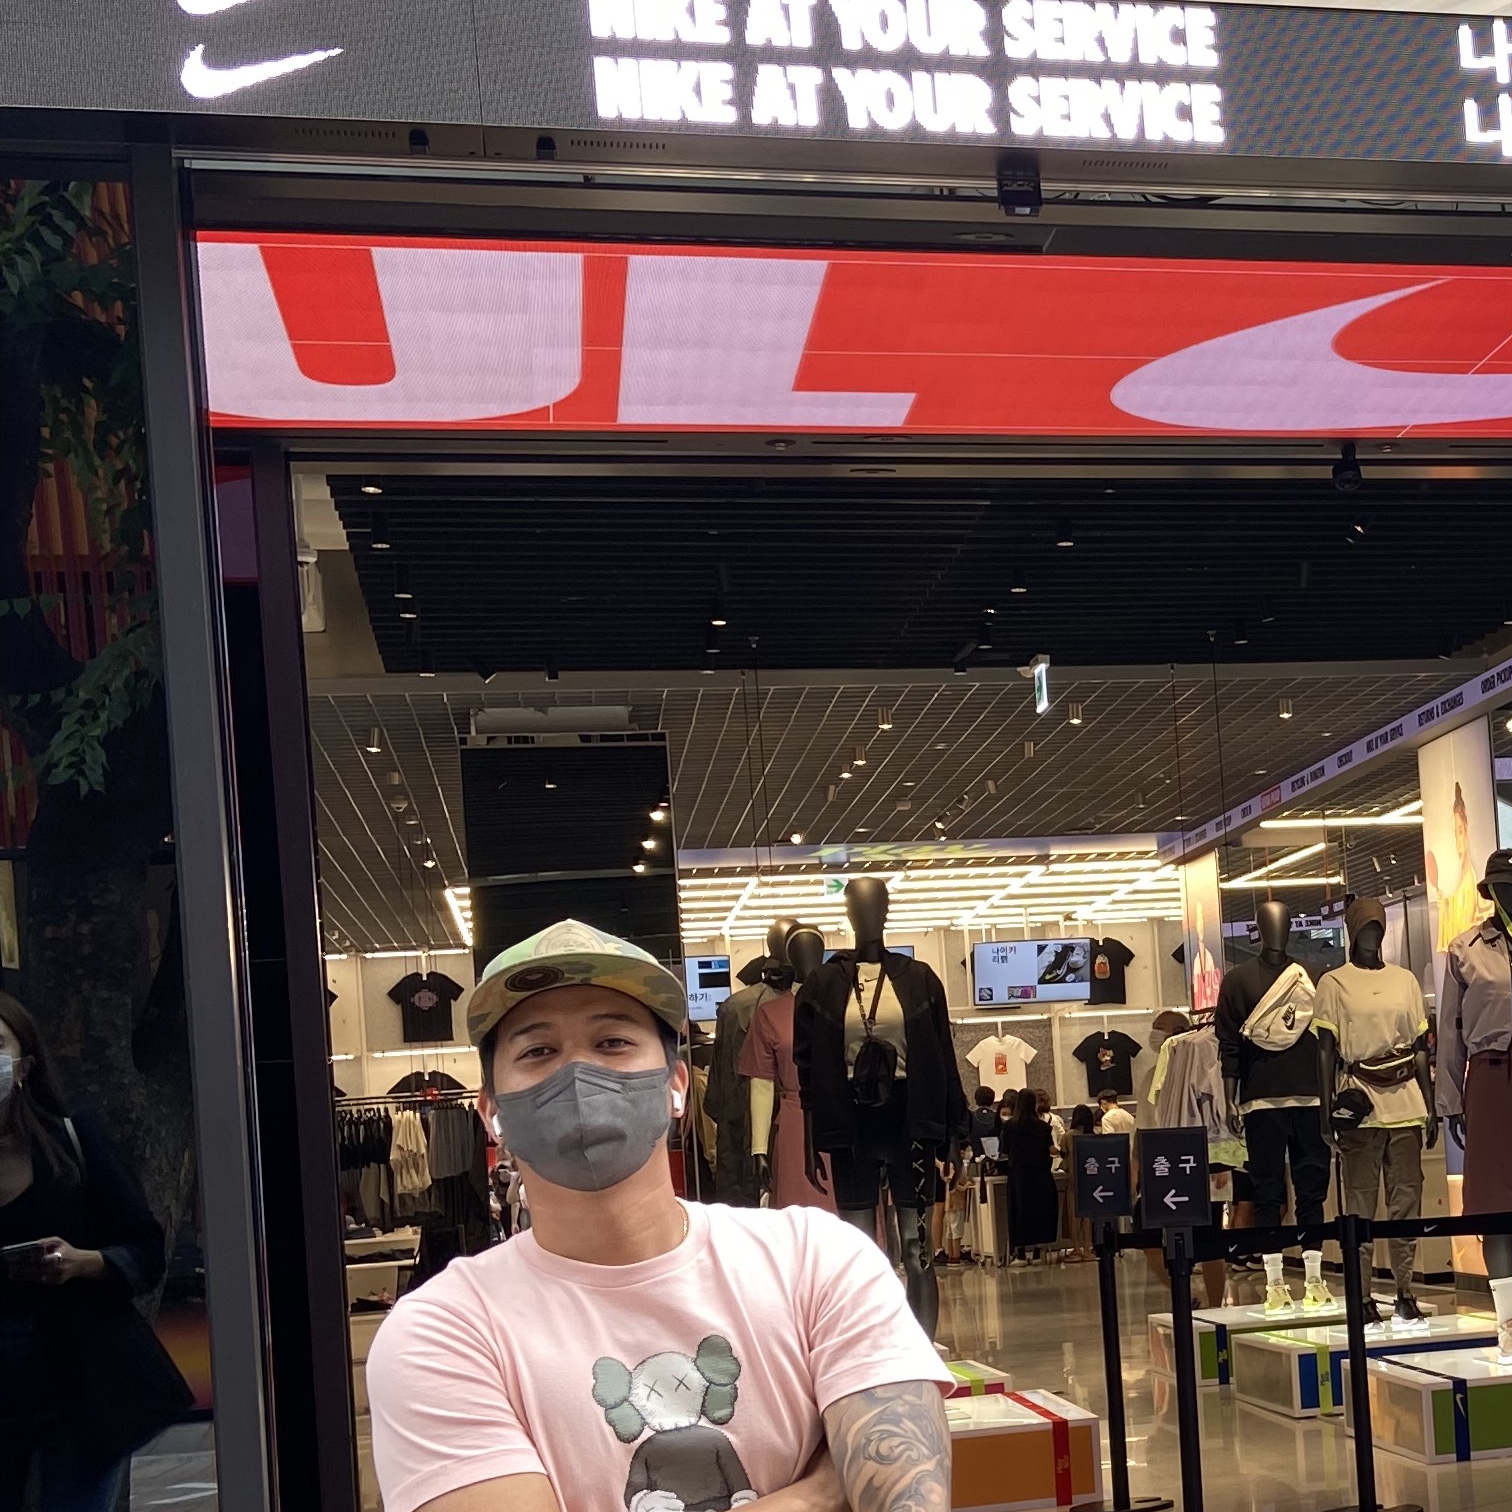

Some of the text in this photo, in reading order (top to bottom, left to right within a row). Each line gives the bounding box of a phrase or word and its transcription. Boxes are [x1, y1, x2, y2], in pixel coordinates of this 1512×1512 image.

[589, 0, 1218, 66] NIKE AT YOUR SERVICE
[594, 57, 1223, 142] NIKE AT YOUR SERVICE
[1084, 1157, 1120, 1175] 출구
[1152, 1155, 1197, 1176] 출구
